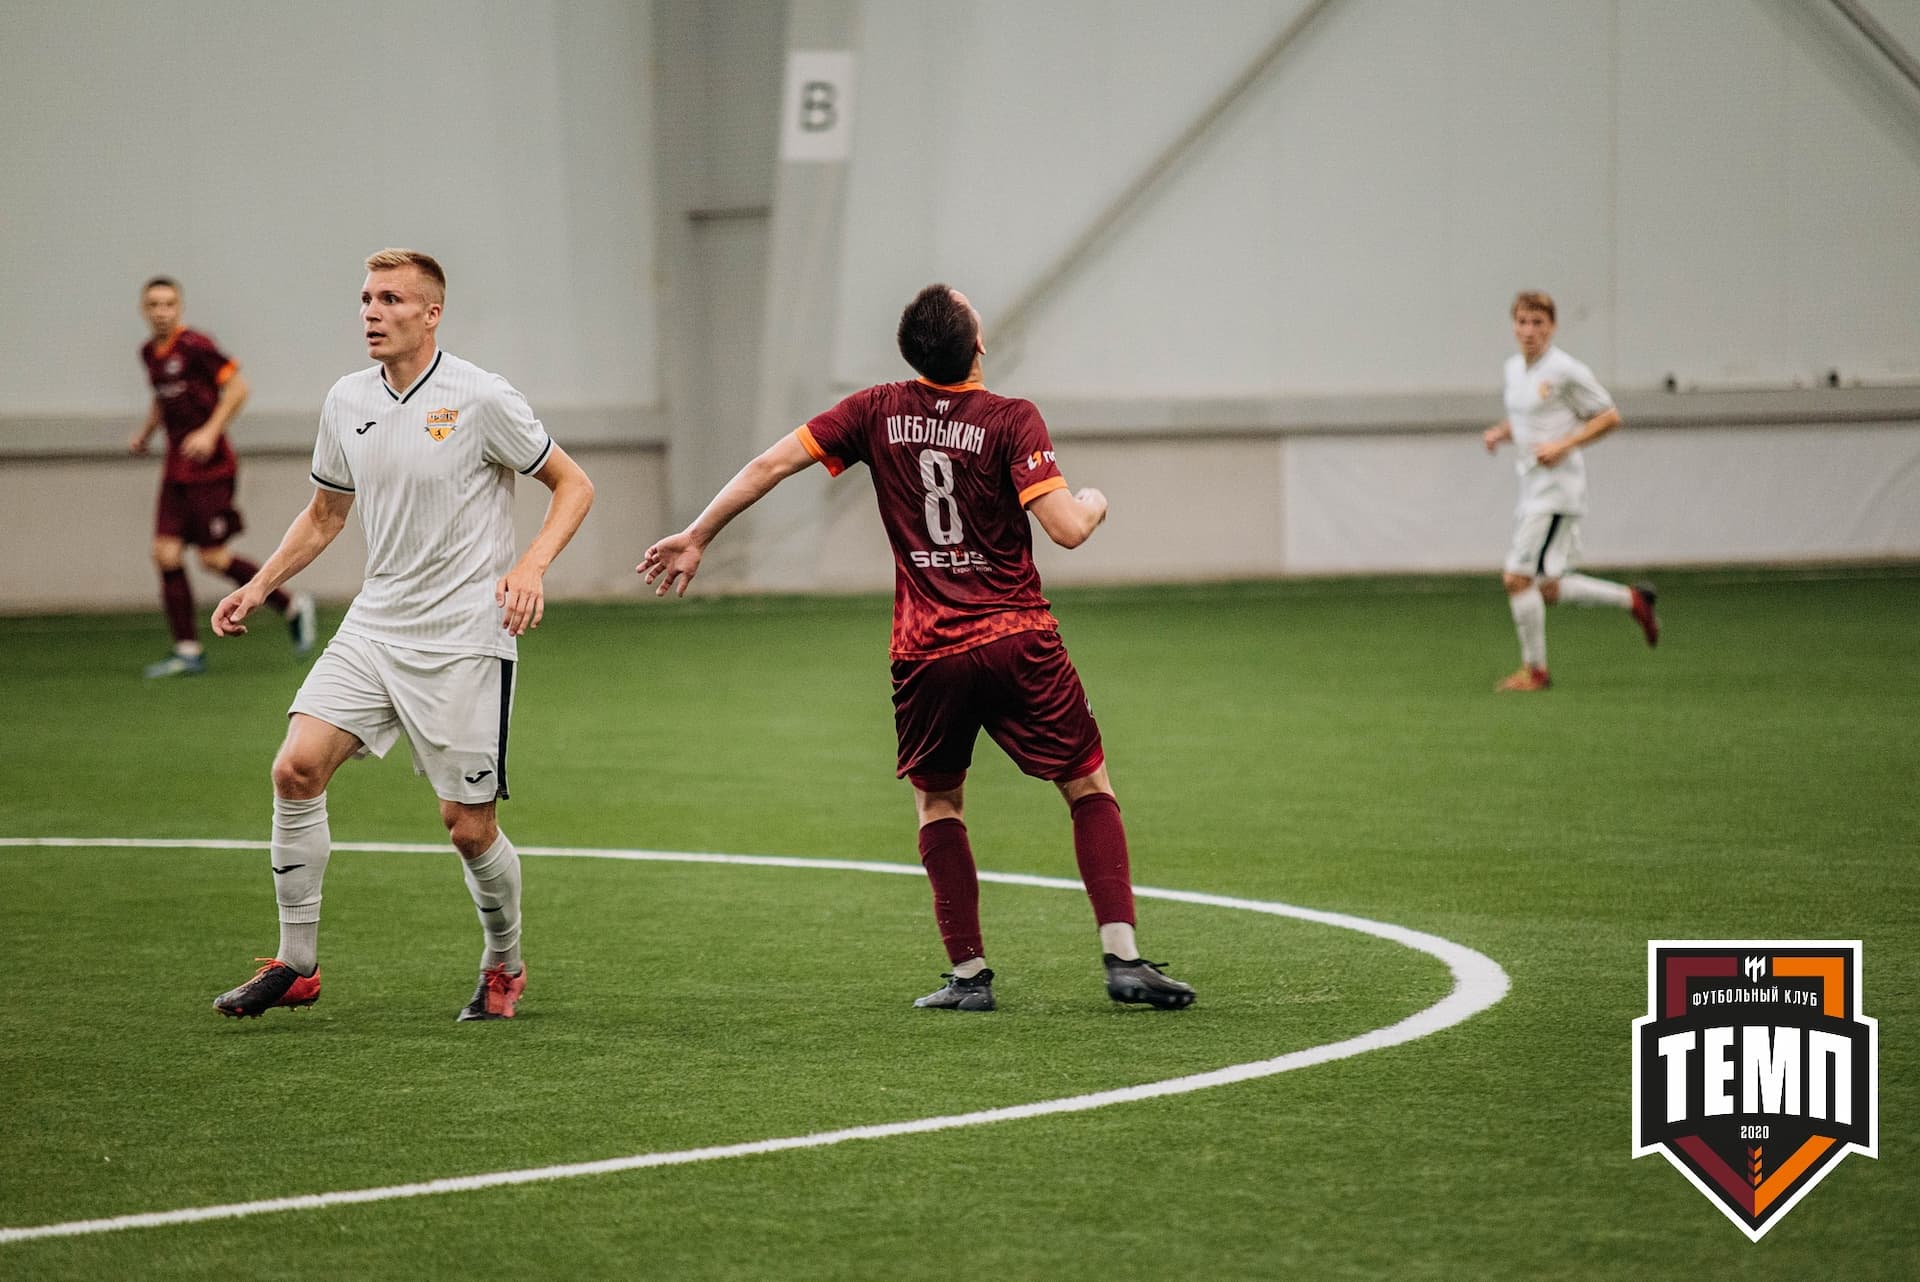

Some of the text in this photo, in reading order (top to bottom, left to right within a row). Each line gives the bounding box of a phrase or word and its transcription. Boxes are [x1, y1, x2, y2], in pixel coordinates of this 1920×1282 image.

[887, 415, 985, 455] ЩЕБЛЫКИН
[919, 448, 964, 545] 8
[910, 550, 988, 568] SEUS
